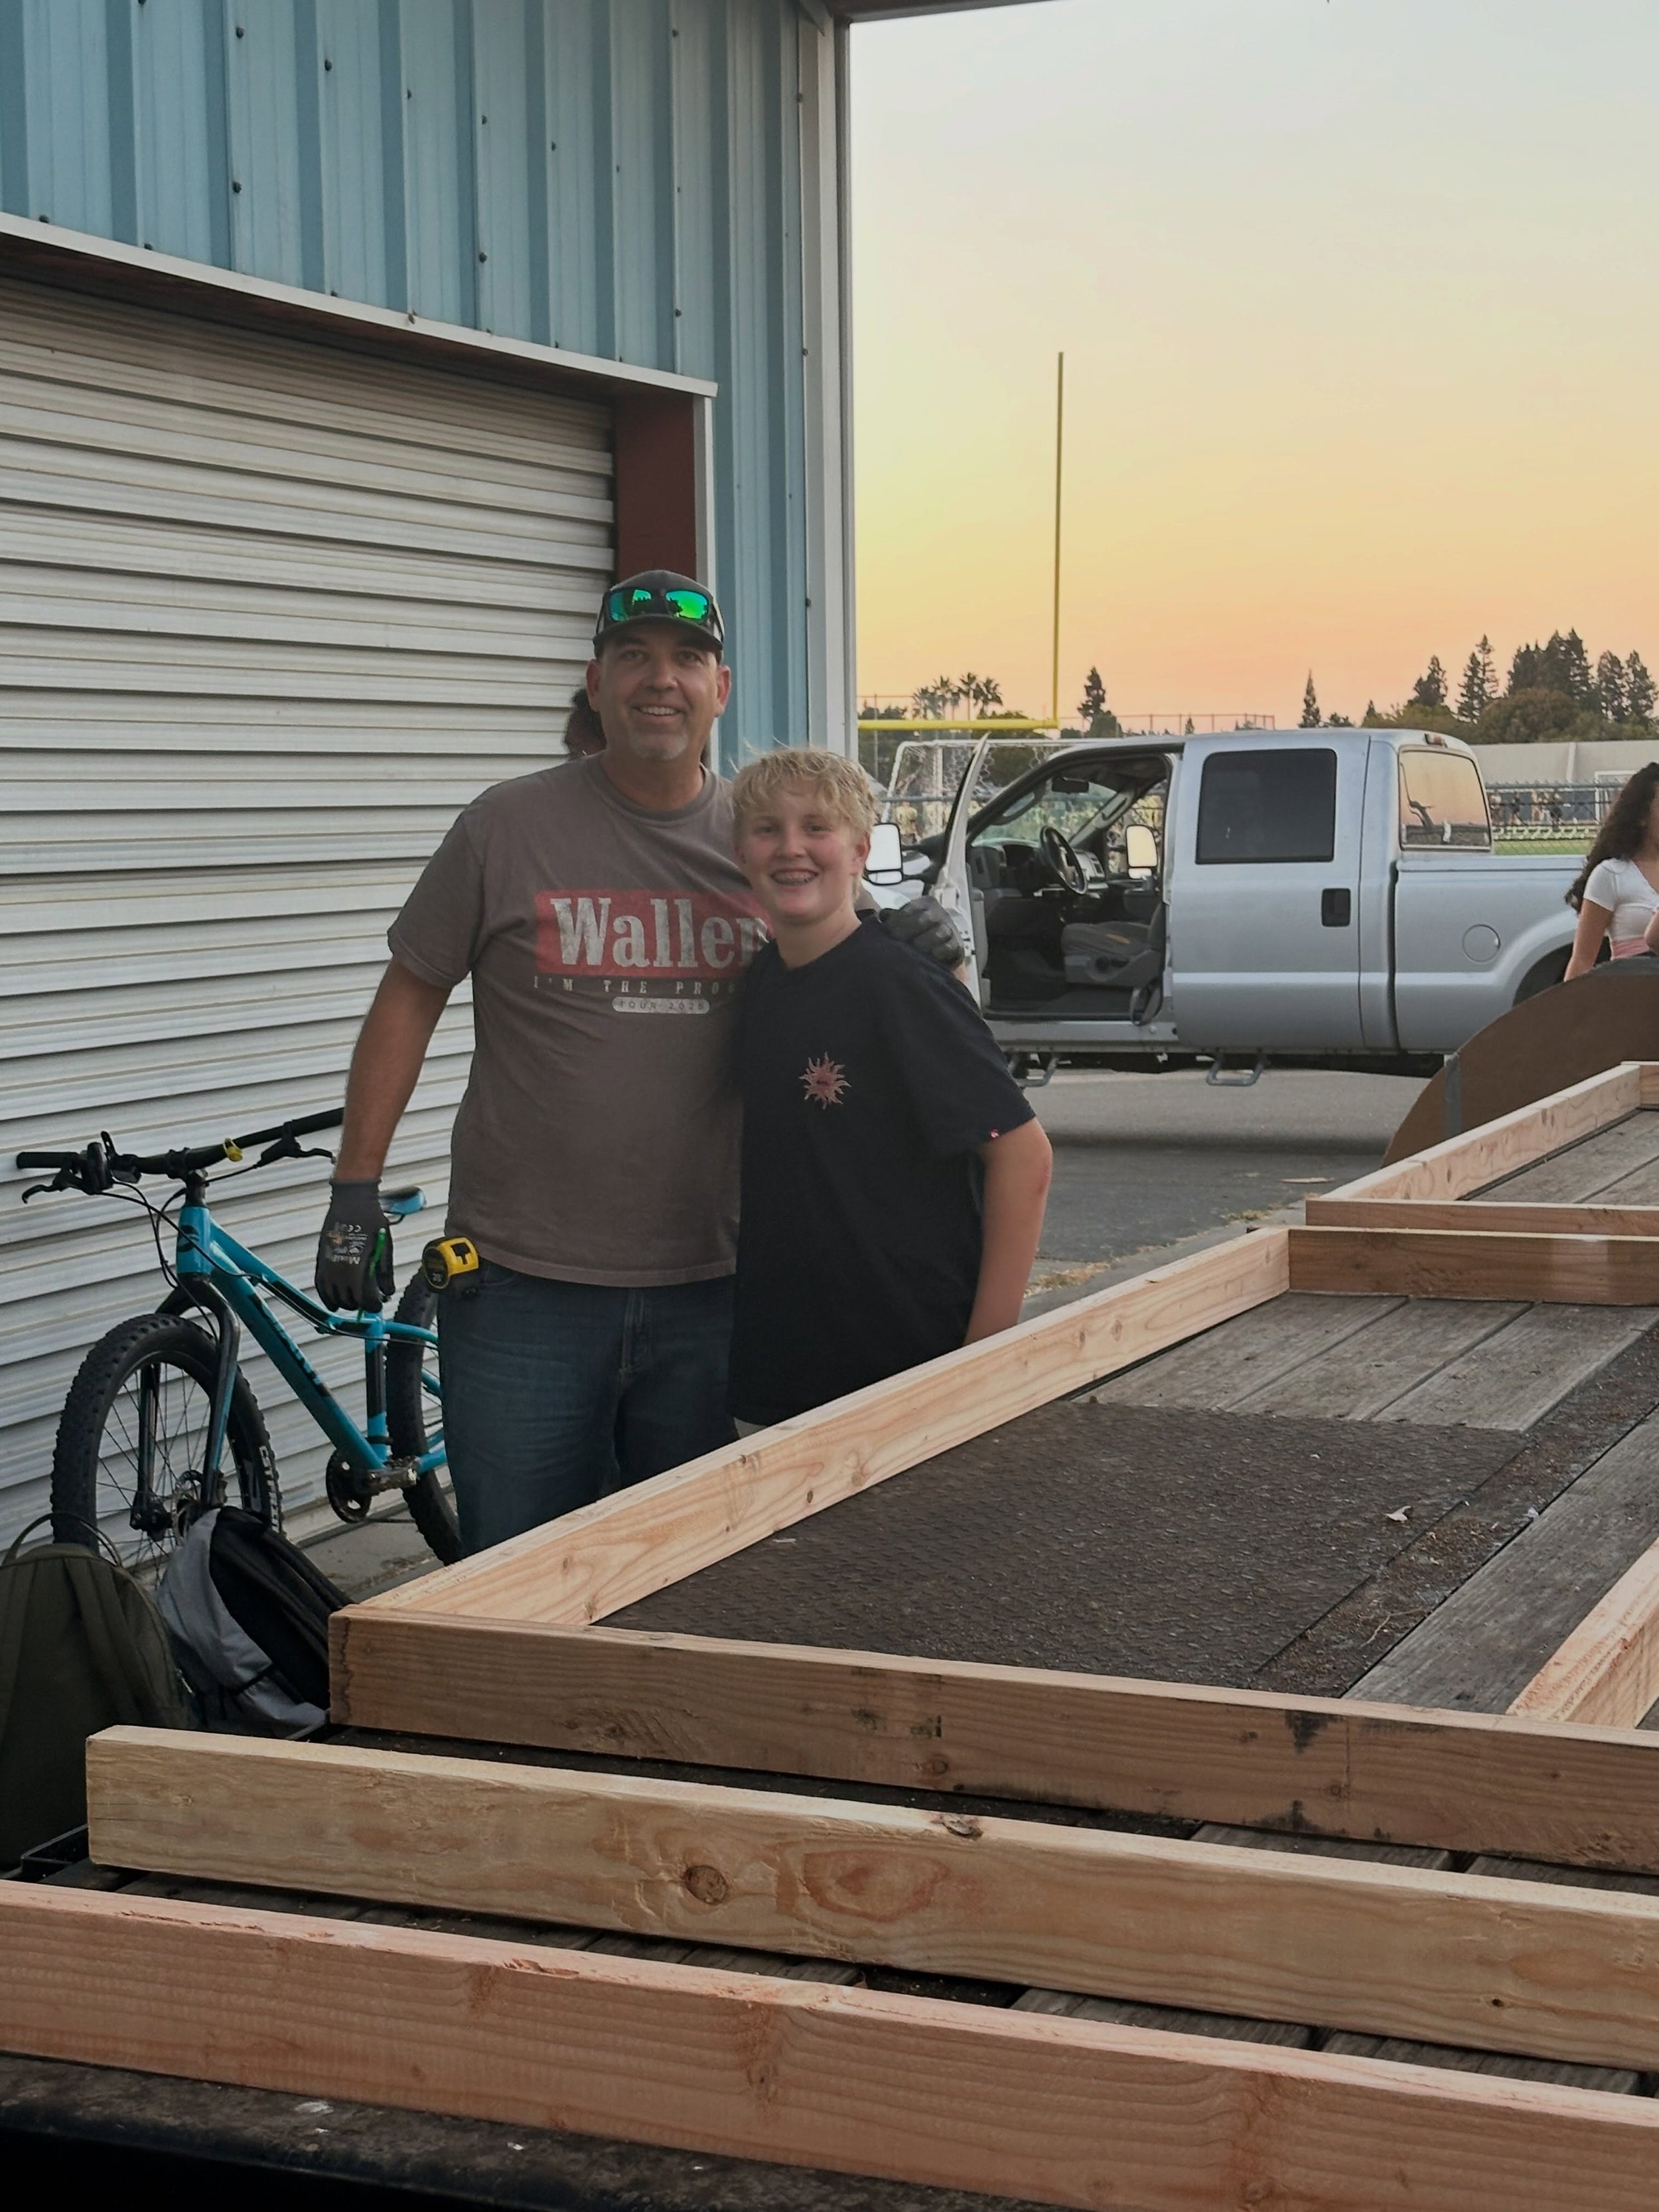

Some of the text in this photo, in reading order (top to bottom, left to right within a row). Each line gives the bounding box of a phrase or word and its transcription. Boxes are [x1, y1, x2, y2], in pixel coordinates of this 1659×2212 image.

[533, 975, 573, 992] I'M
[603, 979, 648, 994] THE
[618, 999, 657, 1011] TOUR
